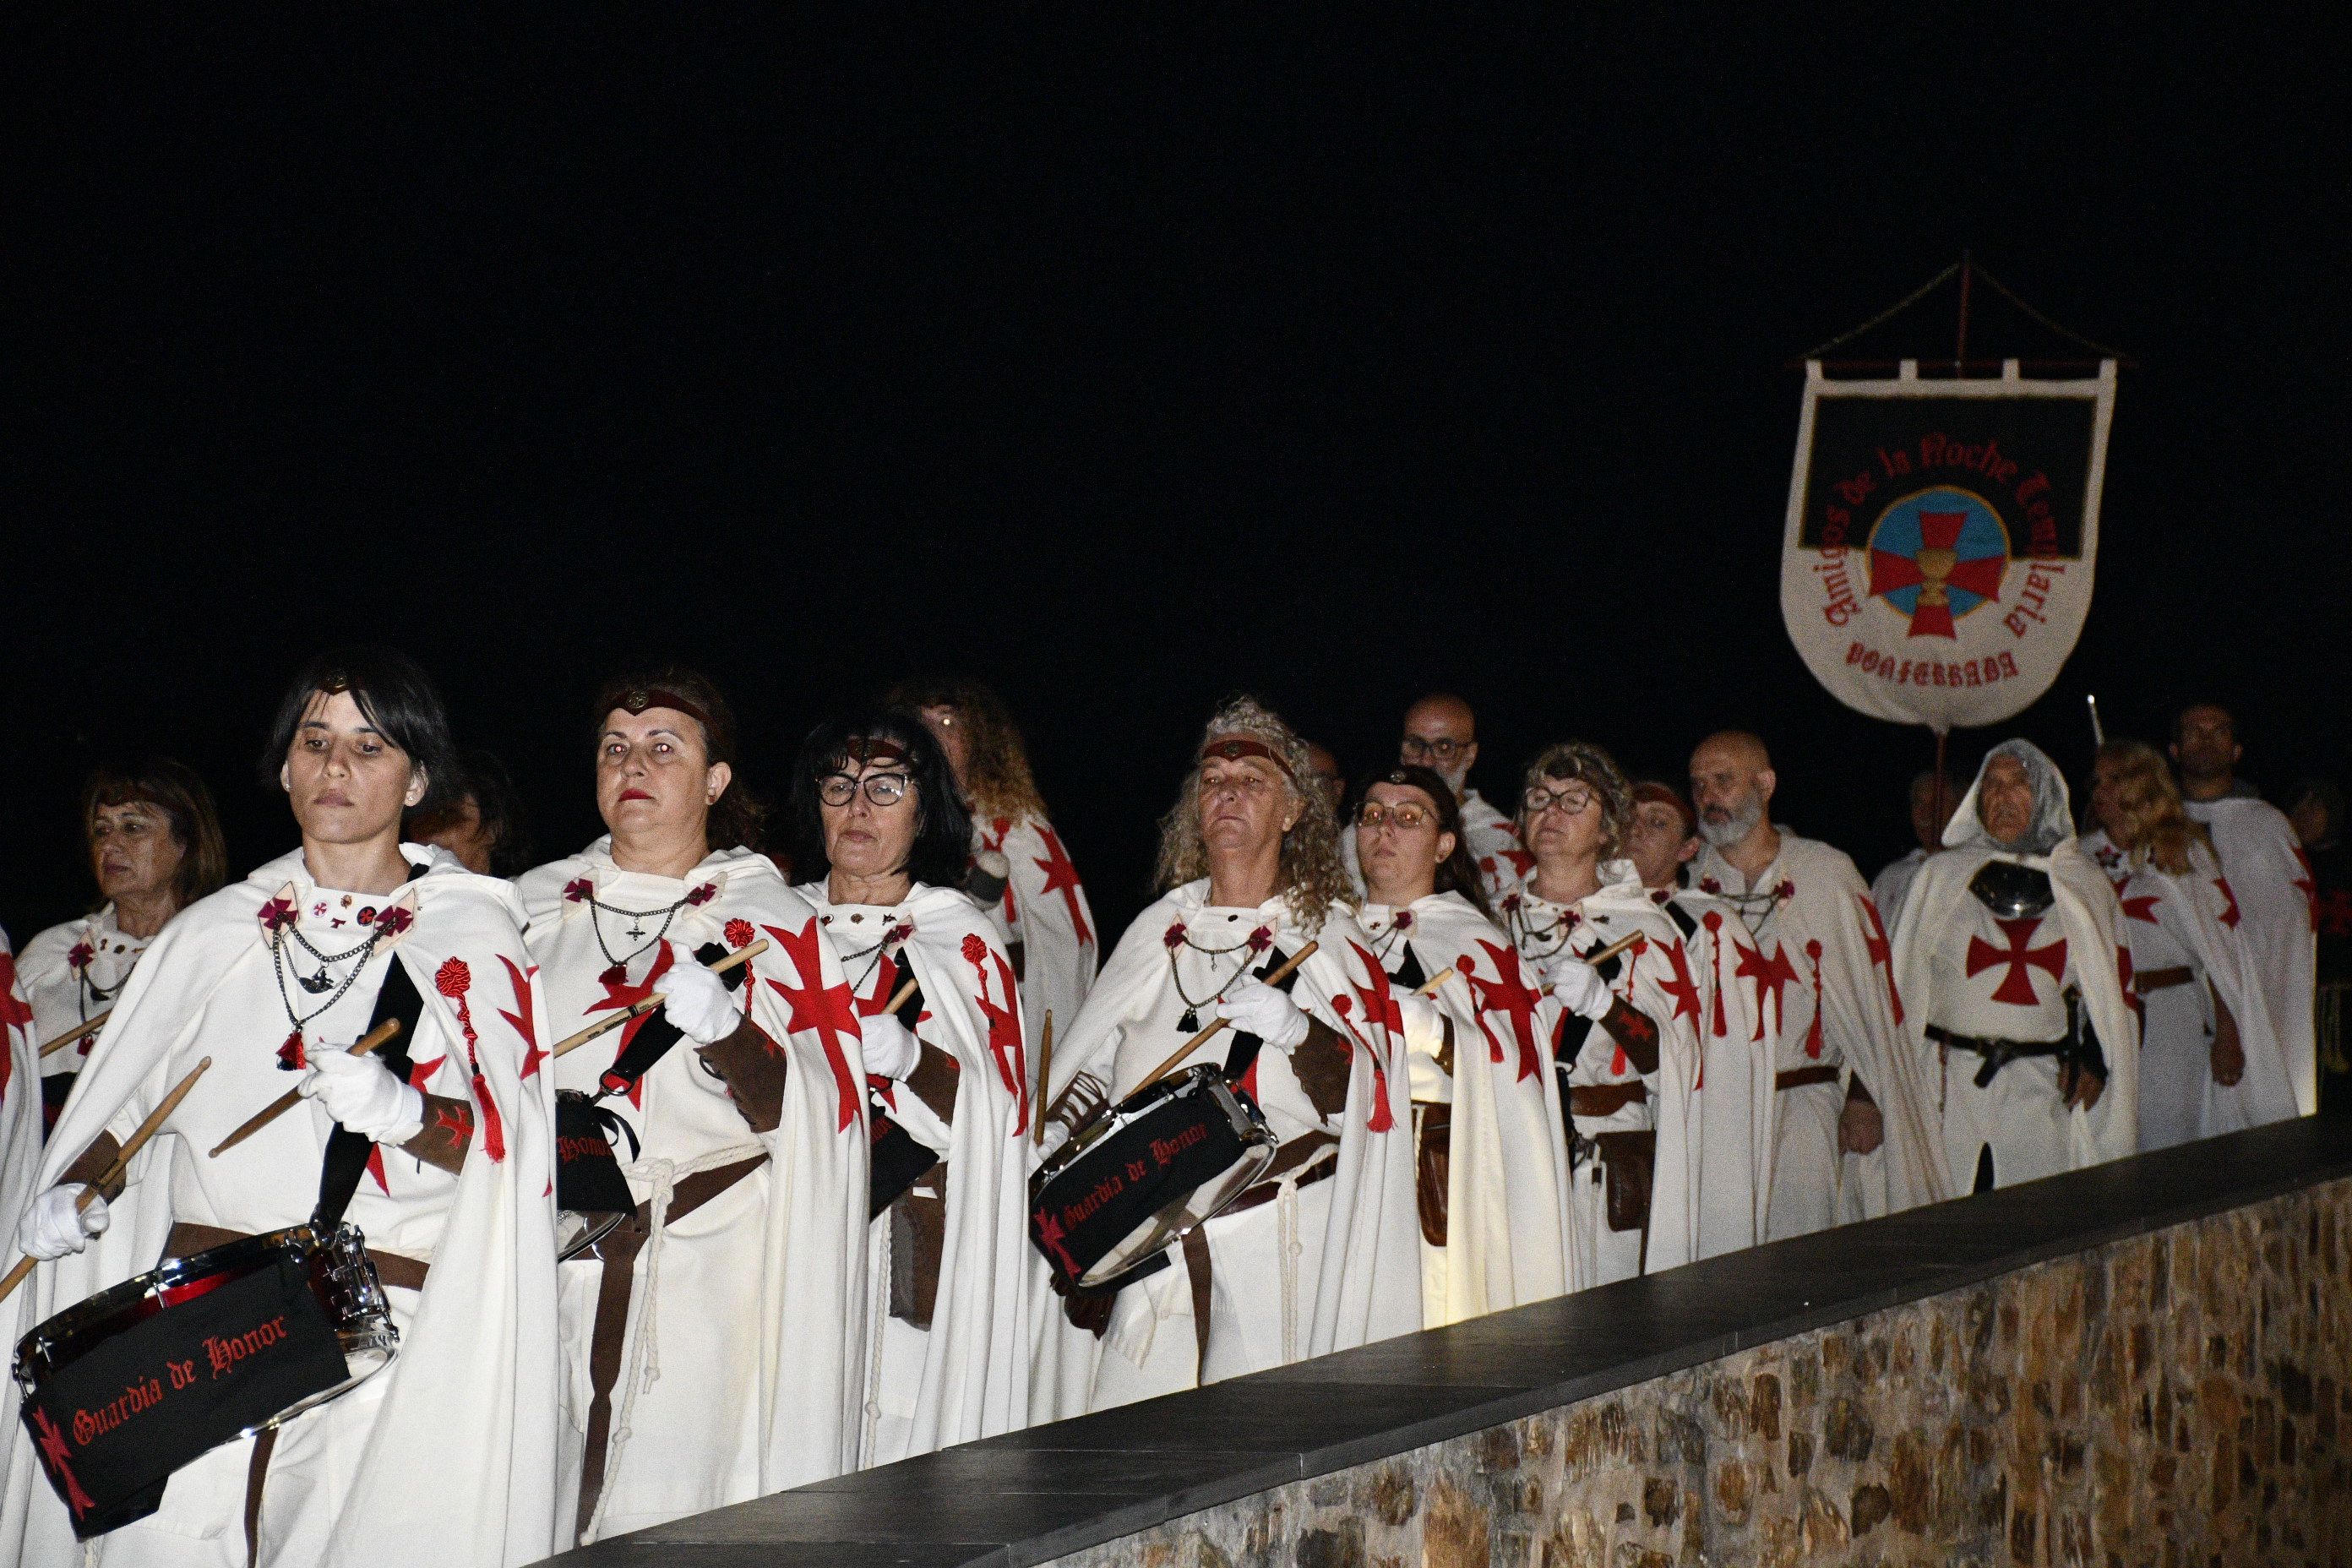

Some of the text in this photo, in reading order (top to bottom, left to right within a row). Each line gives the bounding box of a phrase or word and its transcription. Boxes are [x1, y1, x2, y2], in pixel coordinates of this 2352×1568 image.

[1814, 432, 2066, 639] Amigos de la Noche Templaria
[1124, 1158, 1147, 1183] de
[1149, 1121, 1210, 1170] Honor
[73, 1315, 288, 1446] Guardia de Honor
